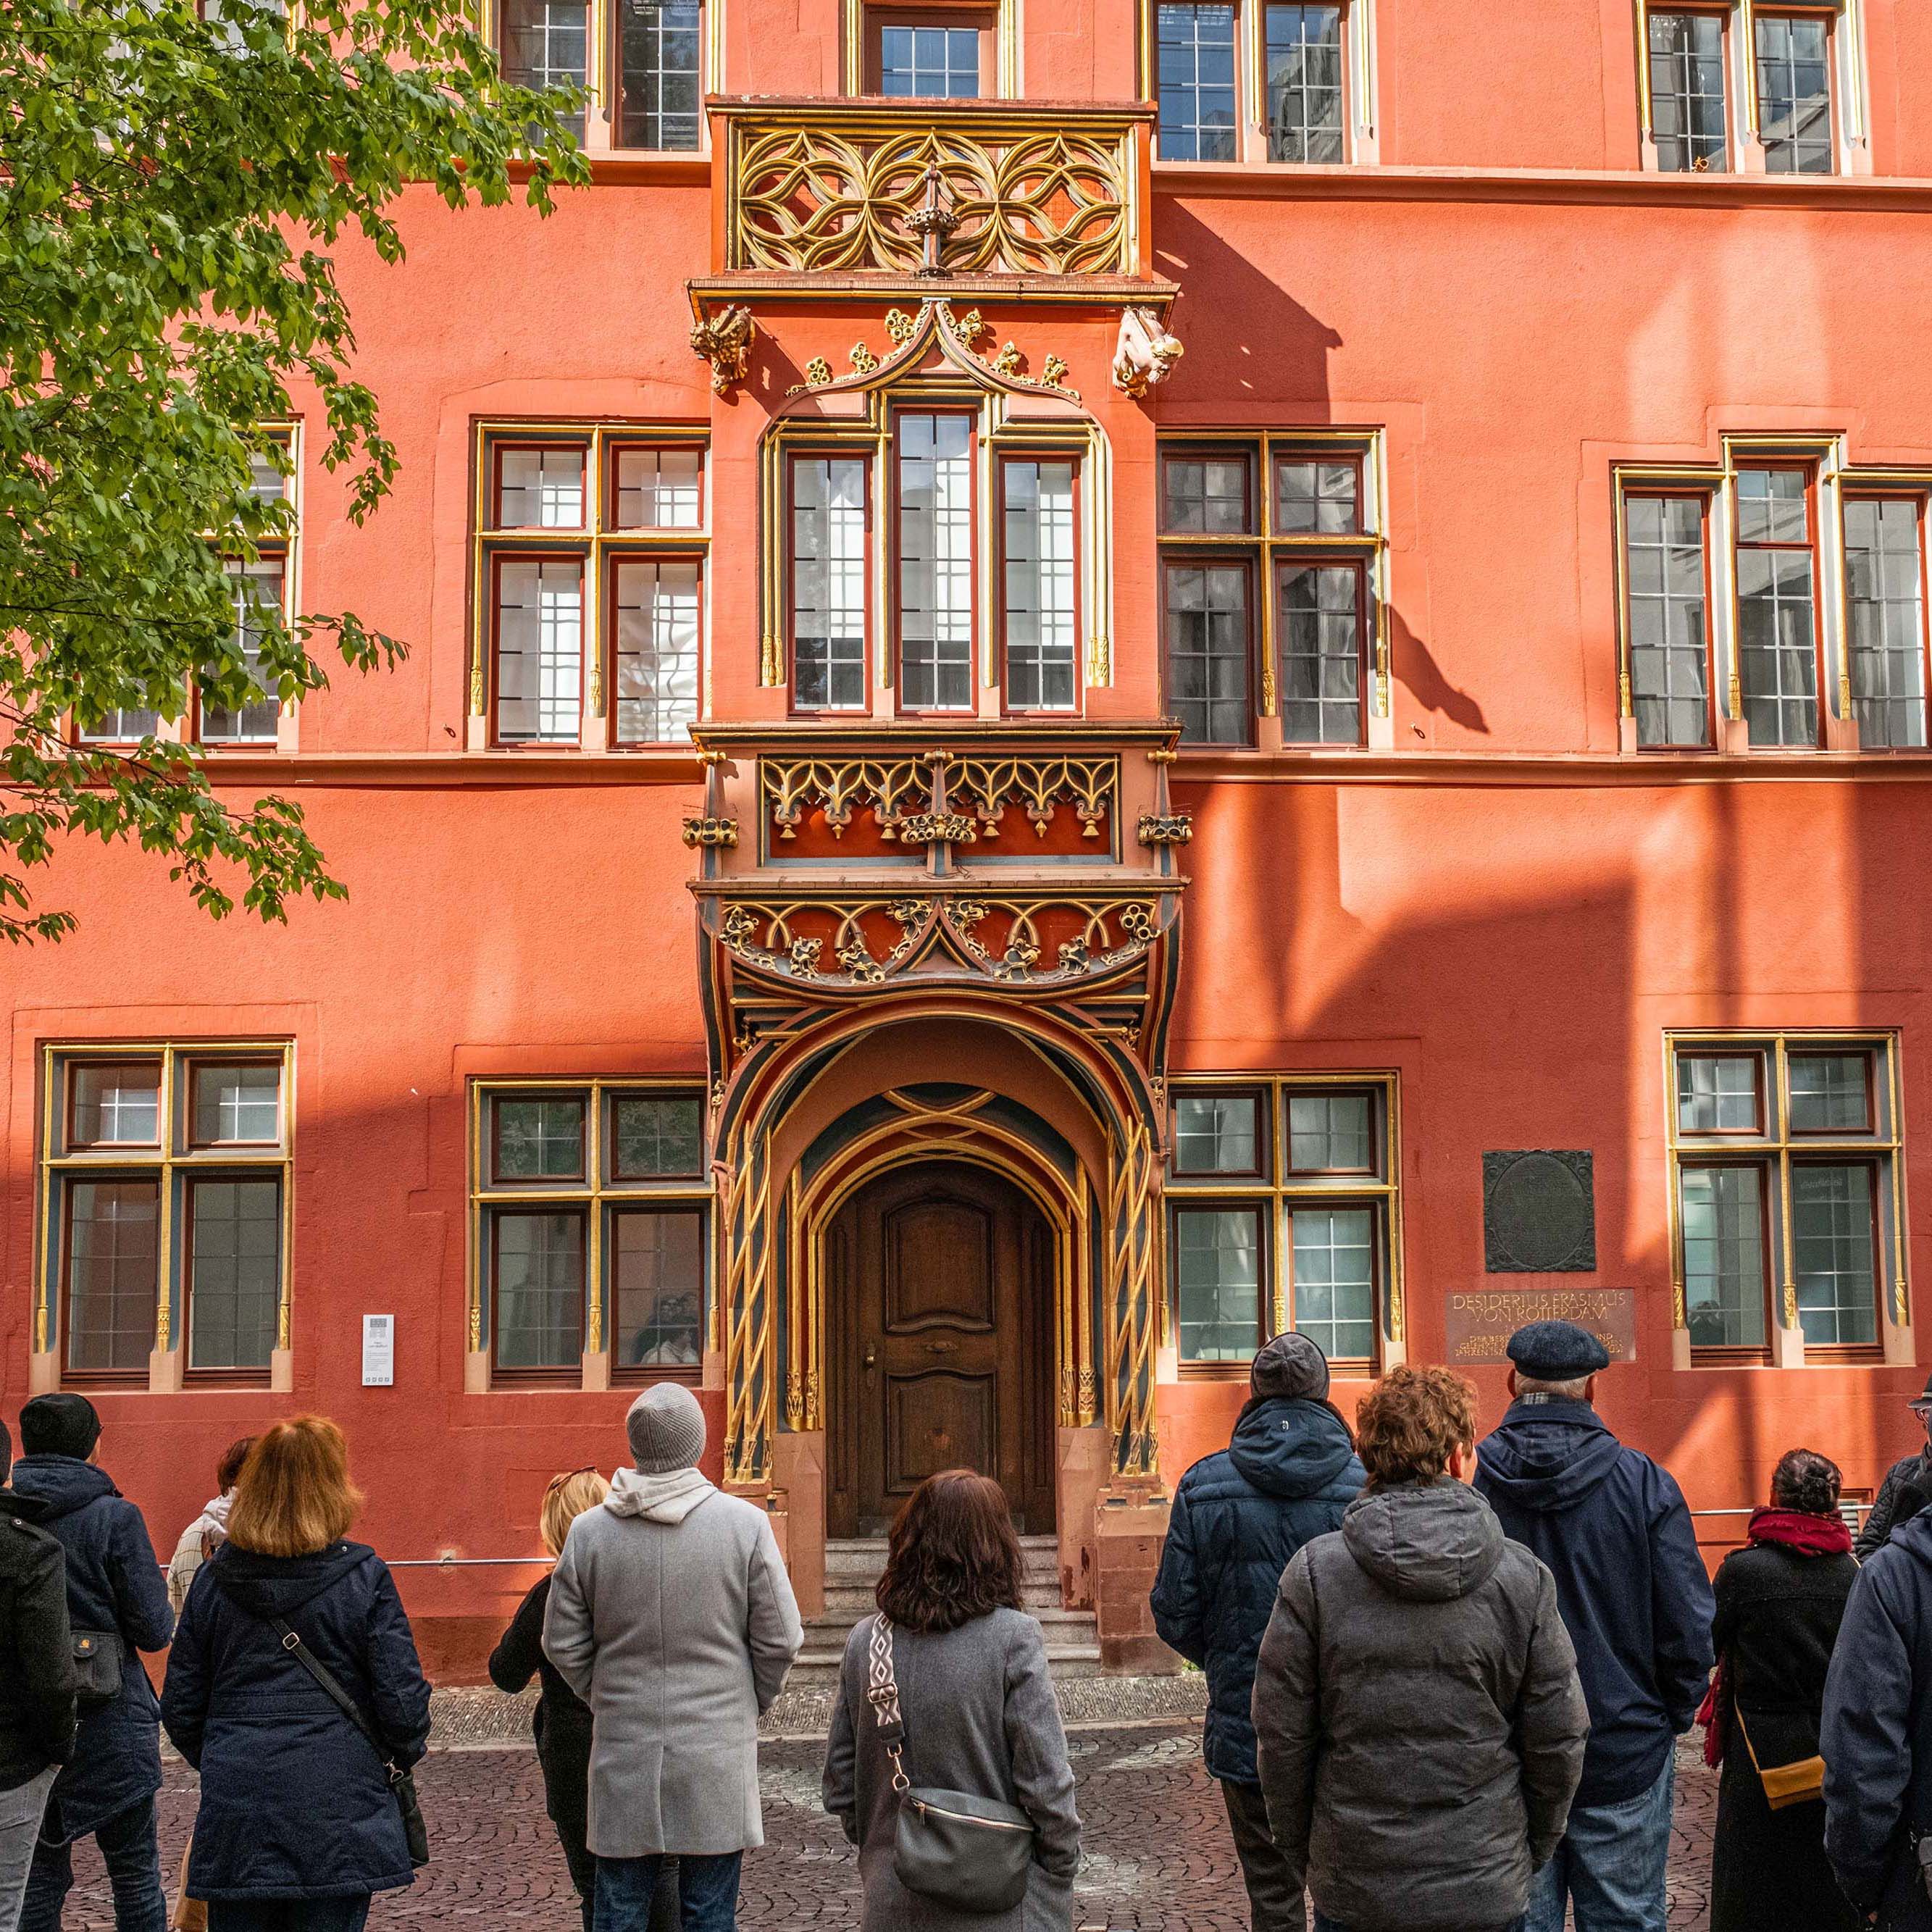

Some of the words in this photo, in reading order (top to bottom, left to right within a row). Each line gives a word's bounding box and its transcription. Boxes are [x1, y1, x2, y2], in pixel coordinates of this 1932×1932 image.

[1452, 1294, 1548, 1310] DESIDERIUS
[1552, 1292, 1626, 1307] ERASMUS
[1471, 1308, 1512, 1322] VON
[1517, 1306, 1608, 1321] ROTTERDAM
